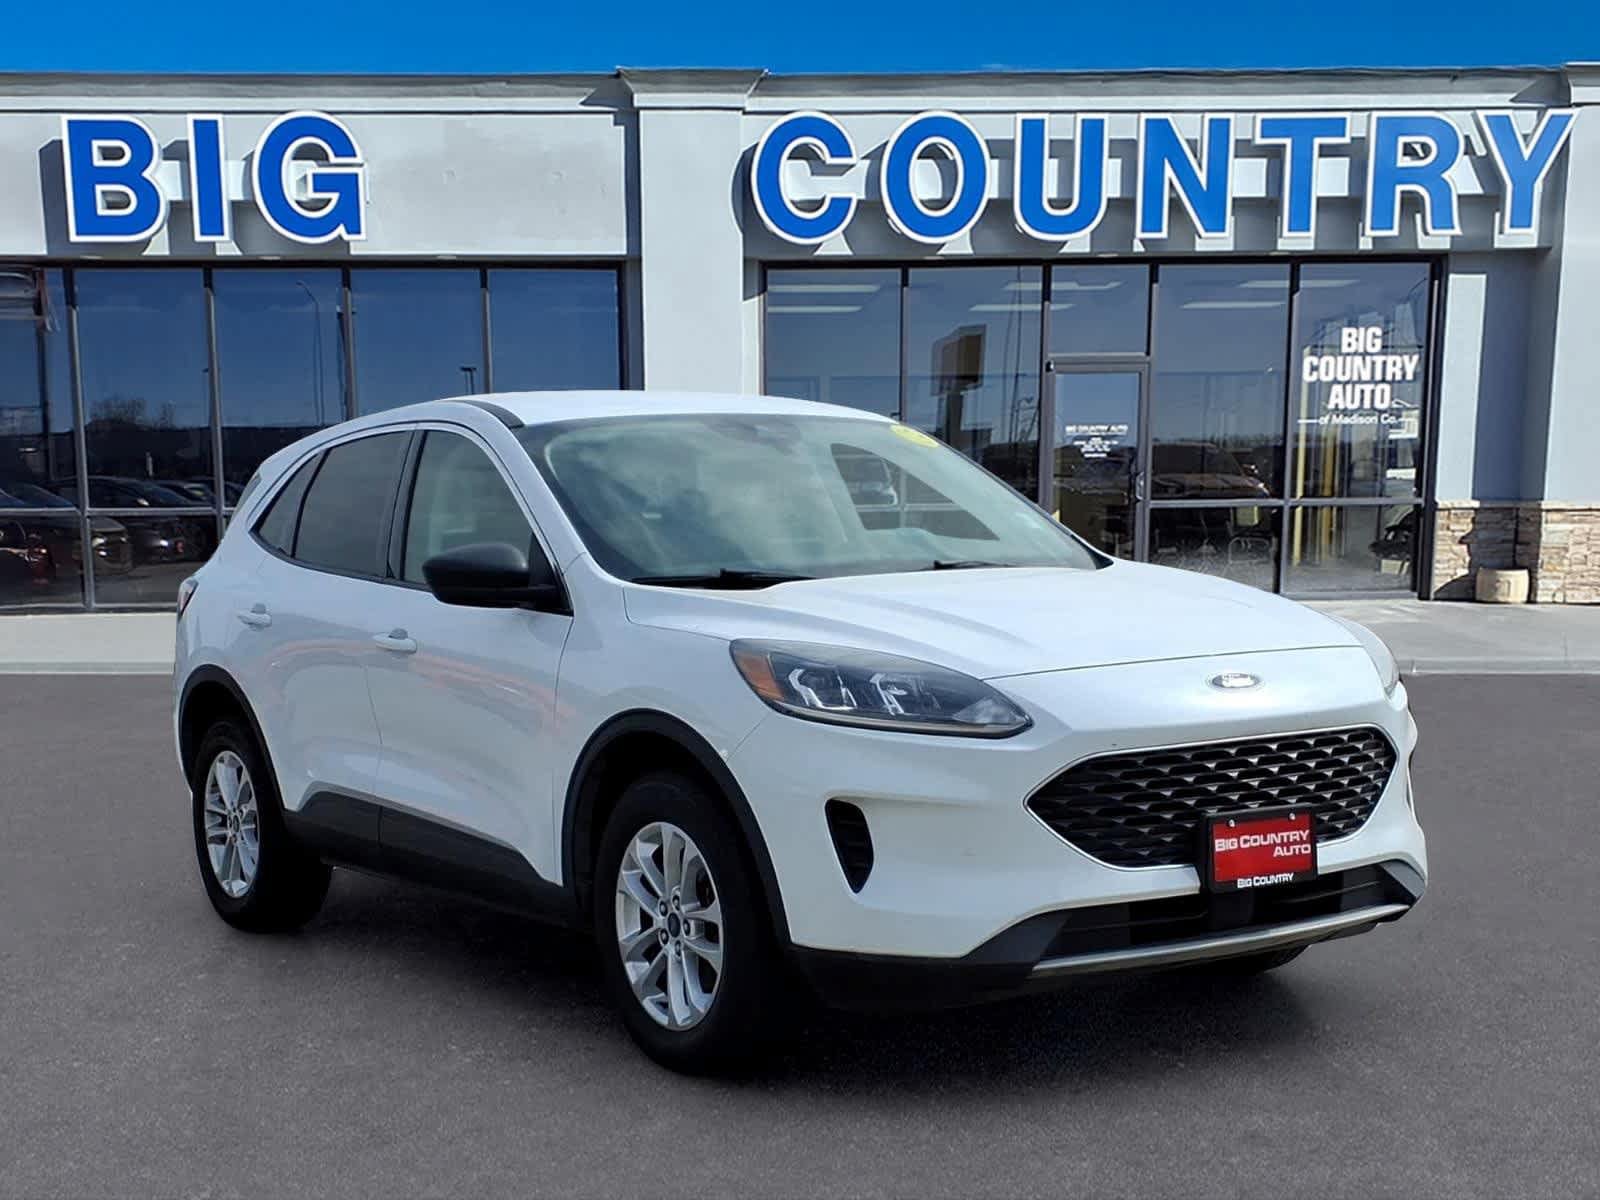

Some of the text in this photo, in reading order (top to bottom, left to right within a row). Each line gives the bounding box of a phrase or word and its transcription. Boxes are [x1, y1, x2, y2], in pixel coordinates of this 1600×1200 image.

[61, 109, 1579, 246] BIG COUNTRY
[1341, 326, 1382, 353] BIG
[1303, 354, 1419, 382] COUNTRY
[1327, 383, 1391, 410] AUTO
[1331, 413, 1378, 425] Madison
[1214, 830, 1309, 852] BIG COUNTRY
[1273, 844, 1311, 857] AUTO
[1237, 873, 1294, 889] BIG COUNTRY
